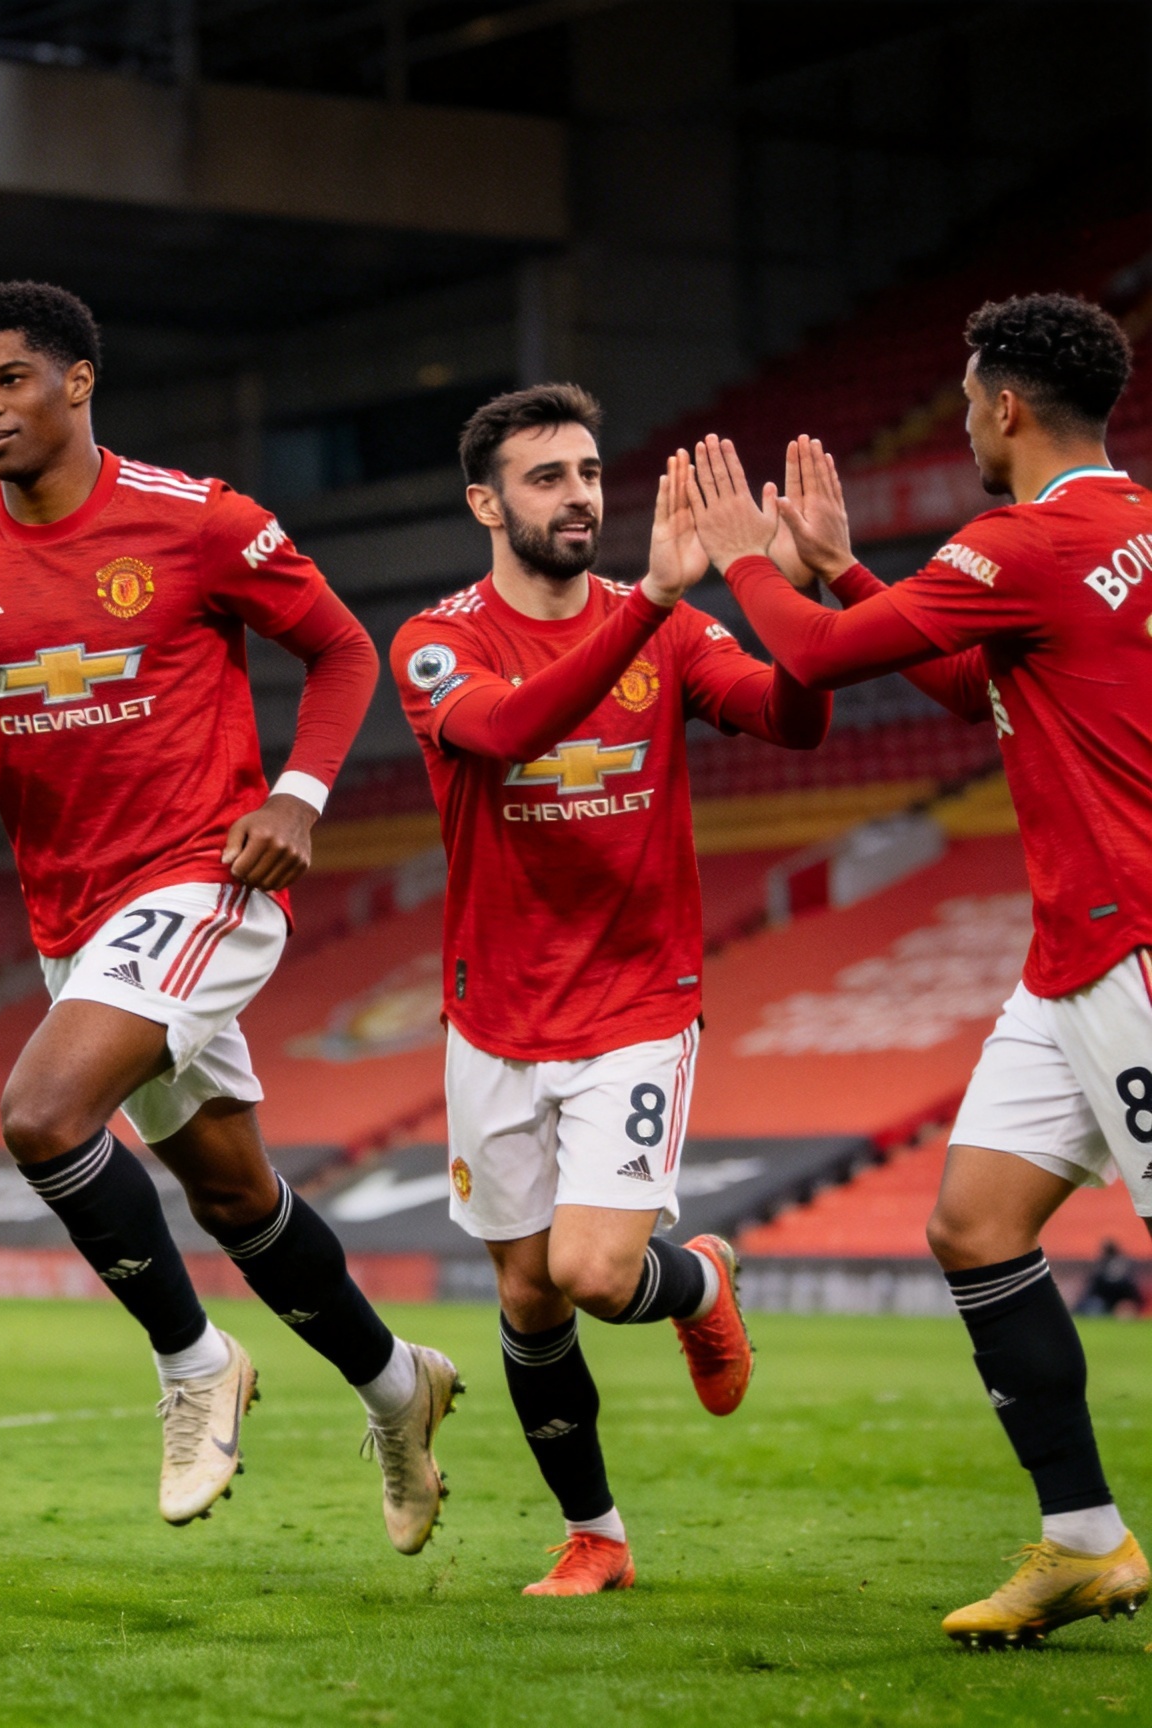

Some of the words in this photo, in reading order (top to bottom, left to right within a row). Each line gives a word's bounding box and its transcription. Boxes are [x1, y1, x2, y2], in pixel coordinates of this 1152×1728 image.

[0, 695, 157, 735] CHEVROLET
[502, 788, 655, 822] CHEVROLET
[625, 1082, 666, 1147] 8
